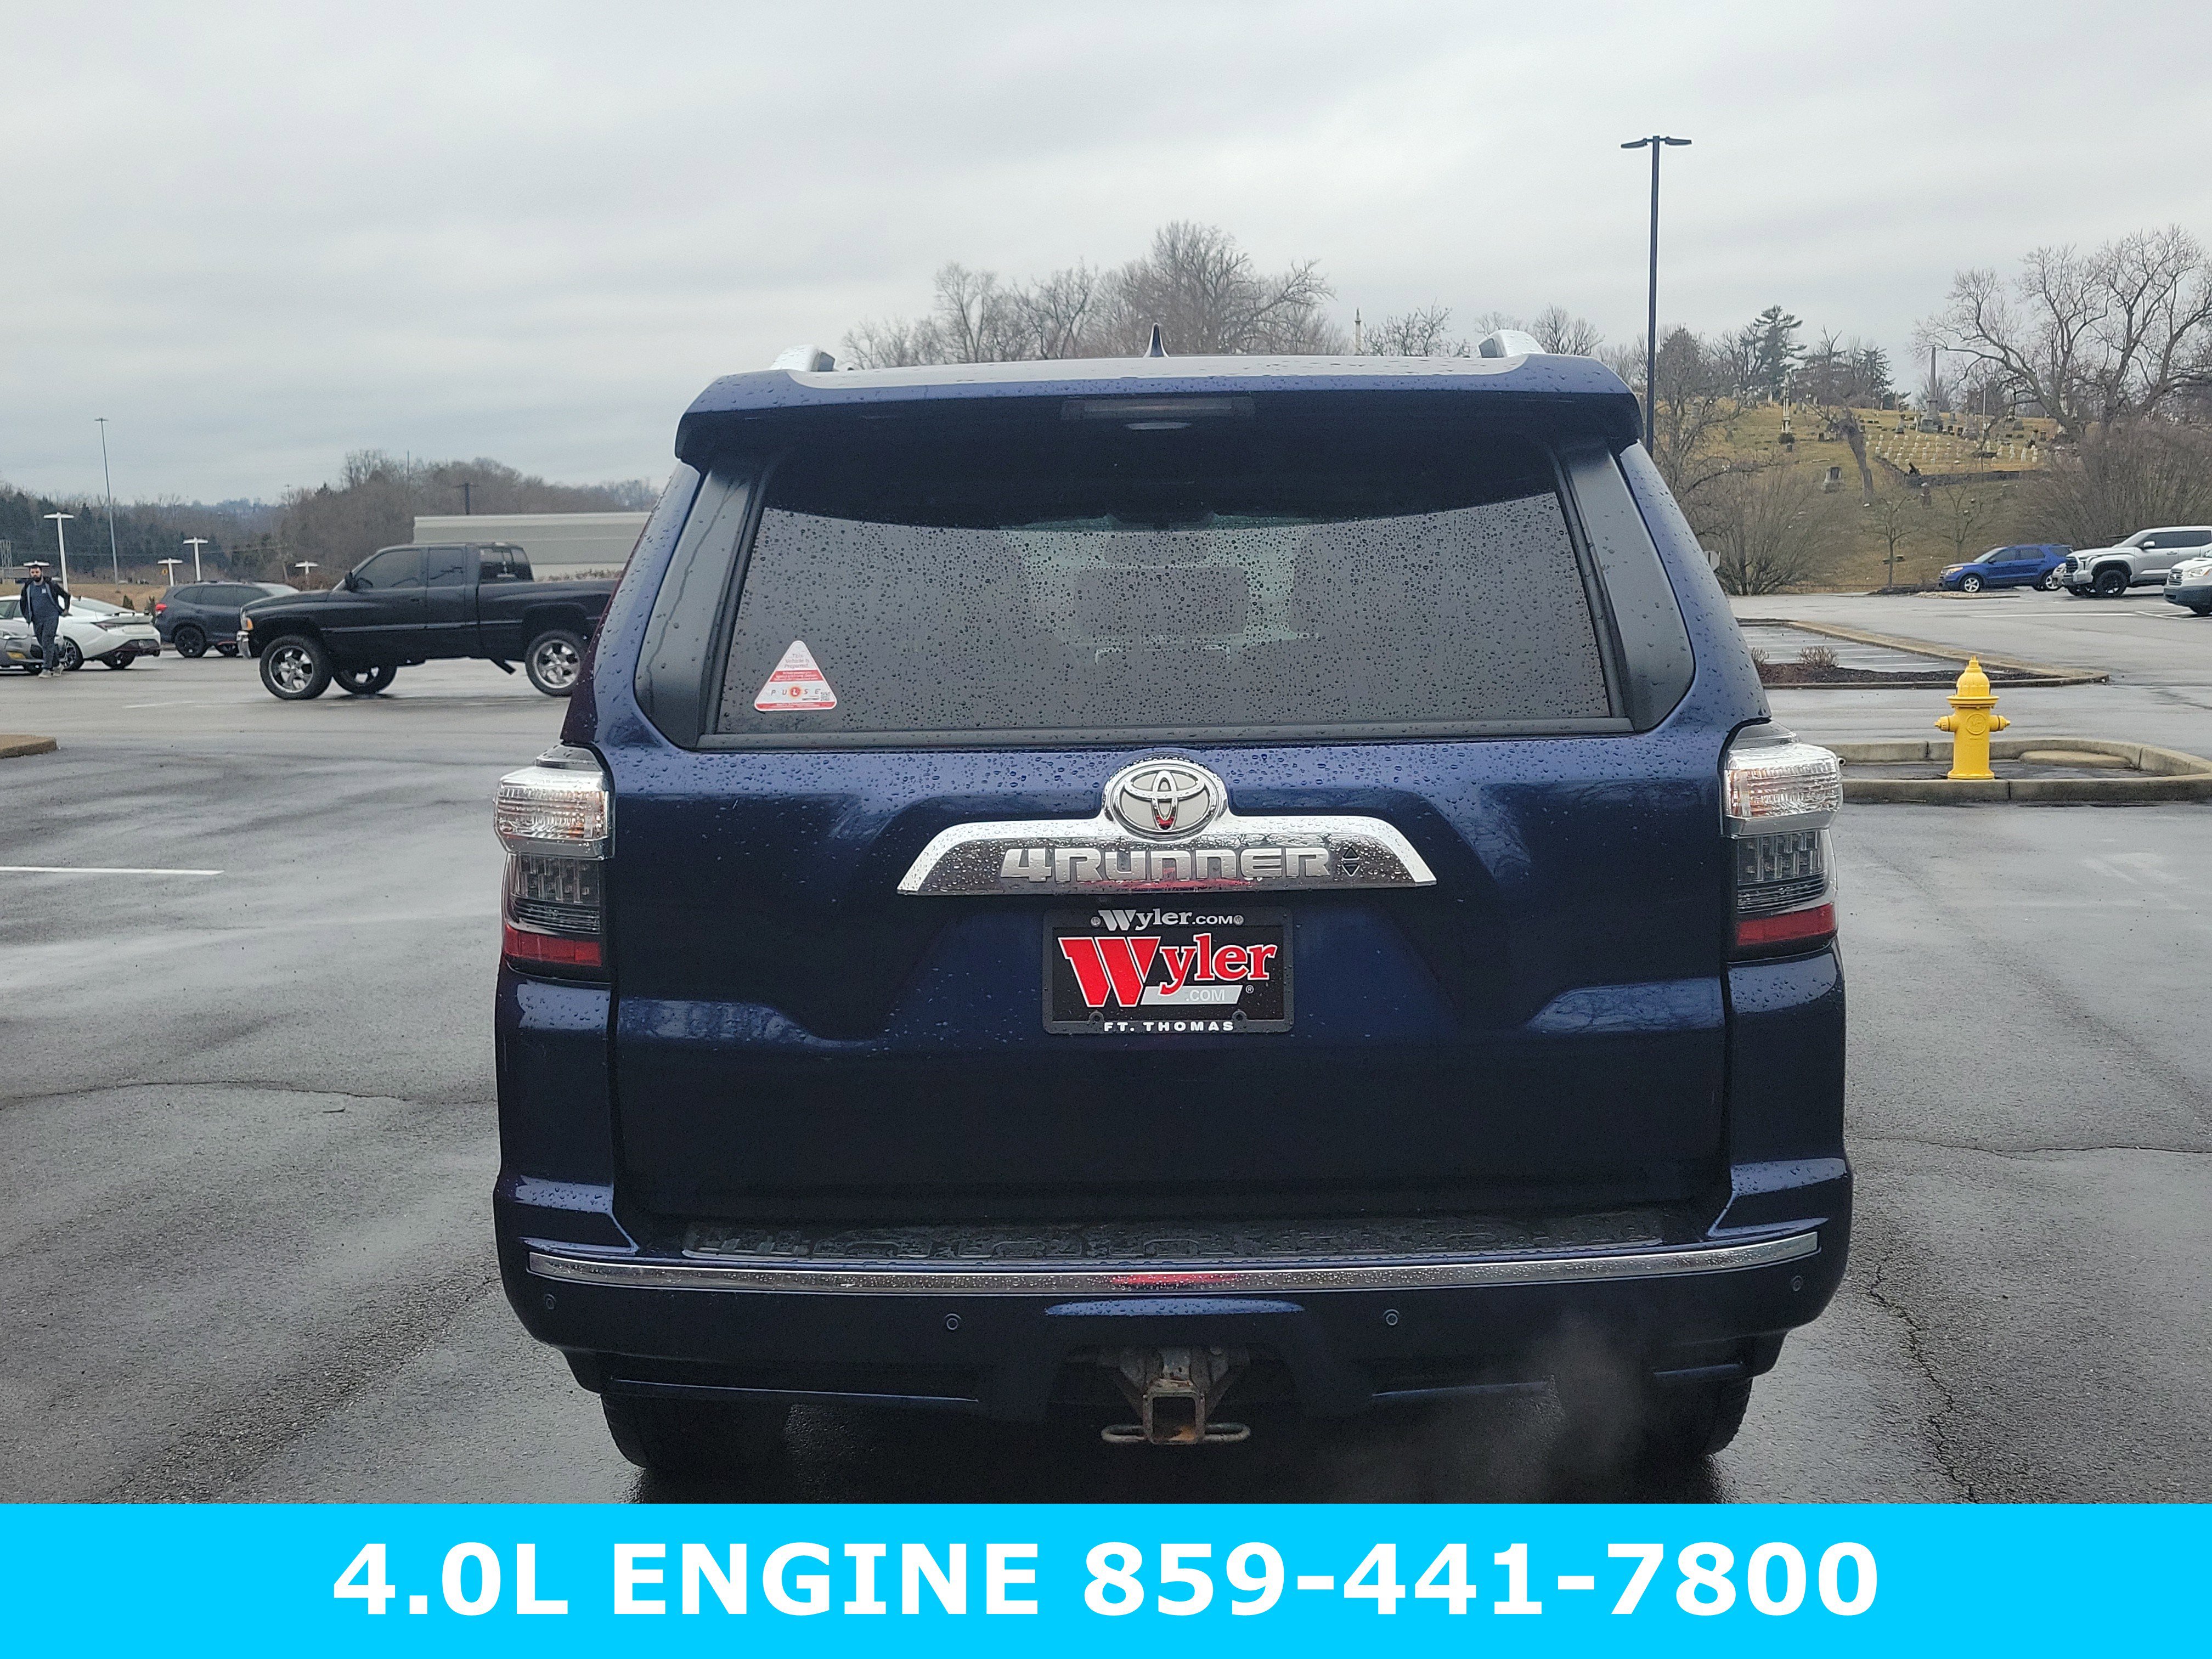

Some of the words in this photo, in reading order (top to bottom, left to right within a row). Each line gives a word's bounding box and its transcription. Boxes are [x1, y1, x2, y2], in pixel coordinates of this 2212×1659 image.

[771, 687, 821, 696] PULSE
[1058, 933, 1278, 1008] Wyler
[1186, 989, 1225, 1002] .COM
[1104, 1022, 1135, 1032] FT.
[1143, 1021, 1234, 1032] THOMAS
